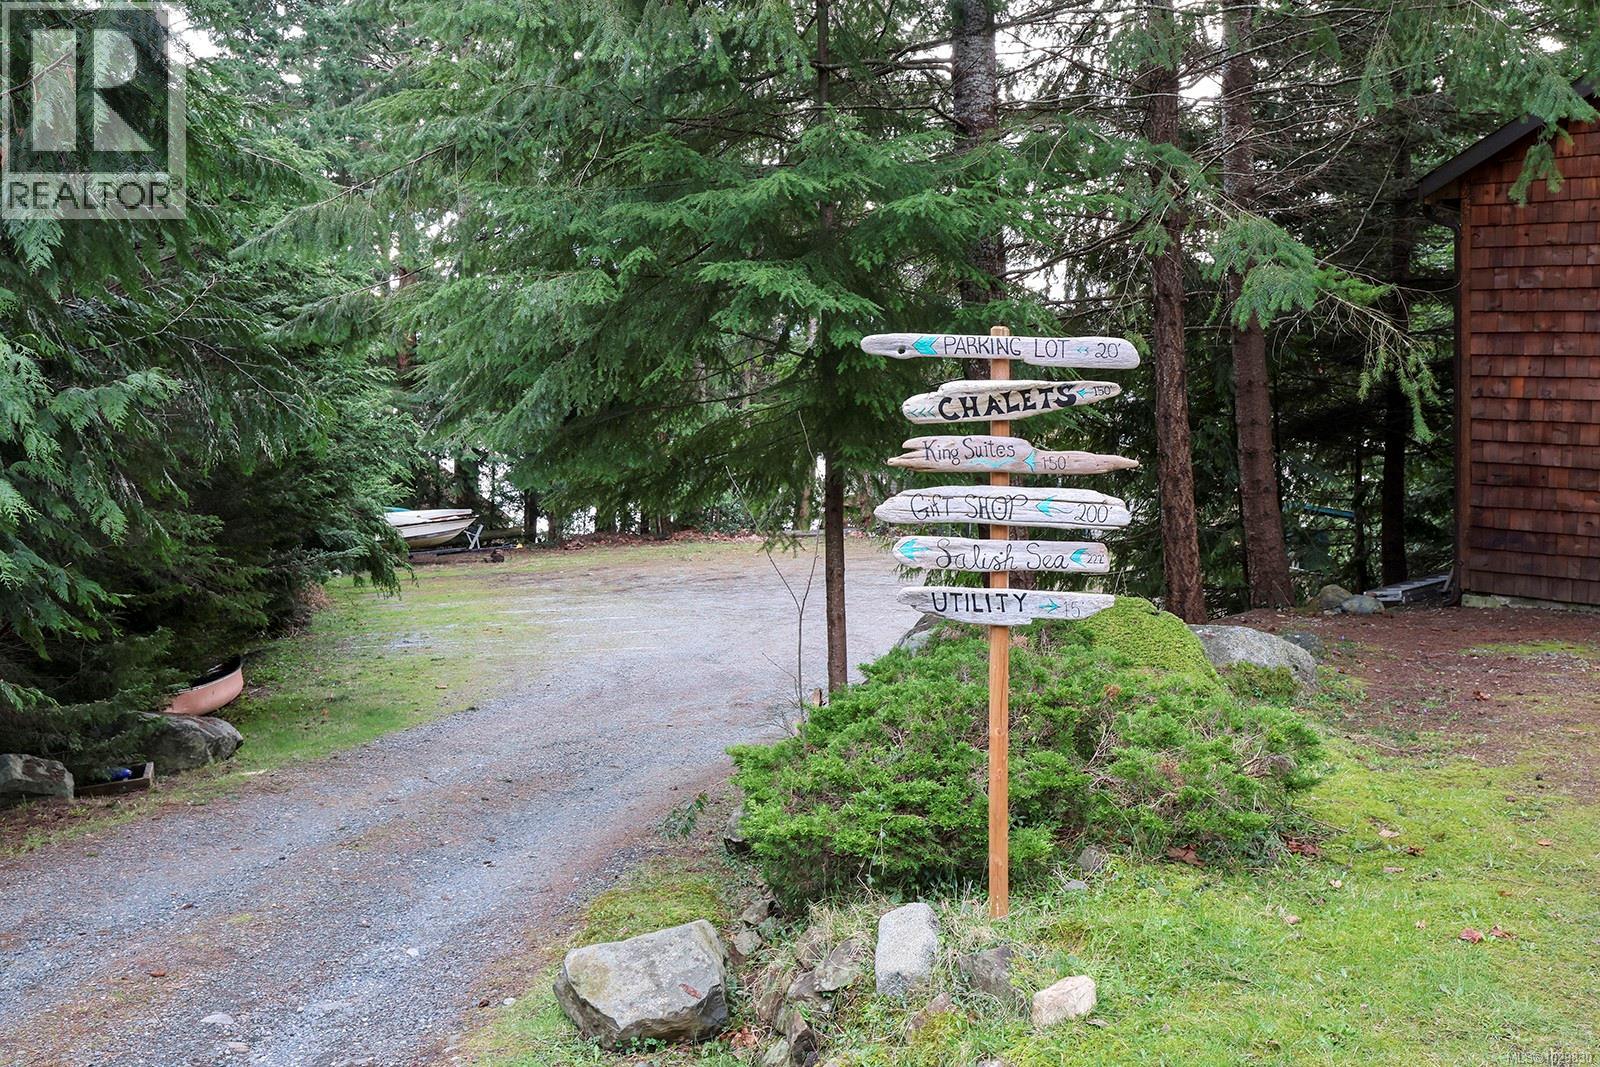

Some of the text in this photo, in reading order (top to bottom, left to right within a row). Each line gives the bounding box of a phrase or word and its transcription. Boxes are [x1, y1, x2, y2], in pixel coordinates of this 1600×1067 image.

[943, 336, 1121, 359] PARKING LOT 20'
[938, 383, 1077, 421] CHALETS
[922, 439, 961, 466] King
[962, 437, 1016, 460] Suites
[964, 493, 1029, 521] SHOP
[935, 537, 1018, 571] Salish
[1026, 542, 1071, 570] Sea
[931, 592, 1027, 613] UTILITY
